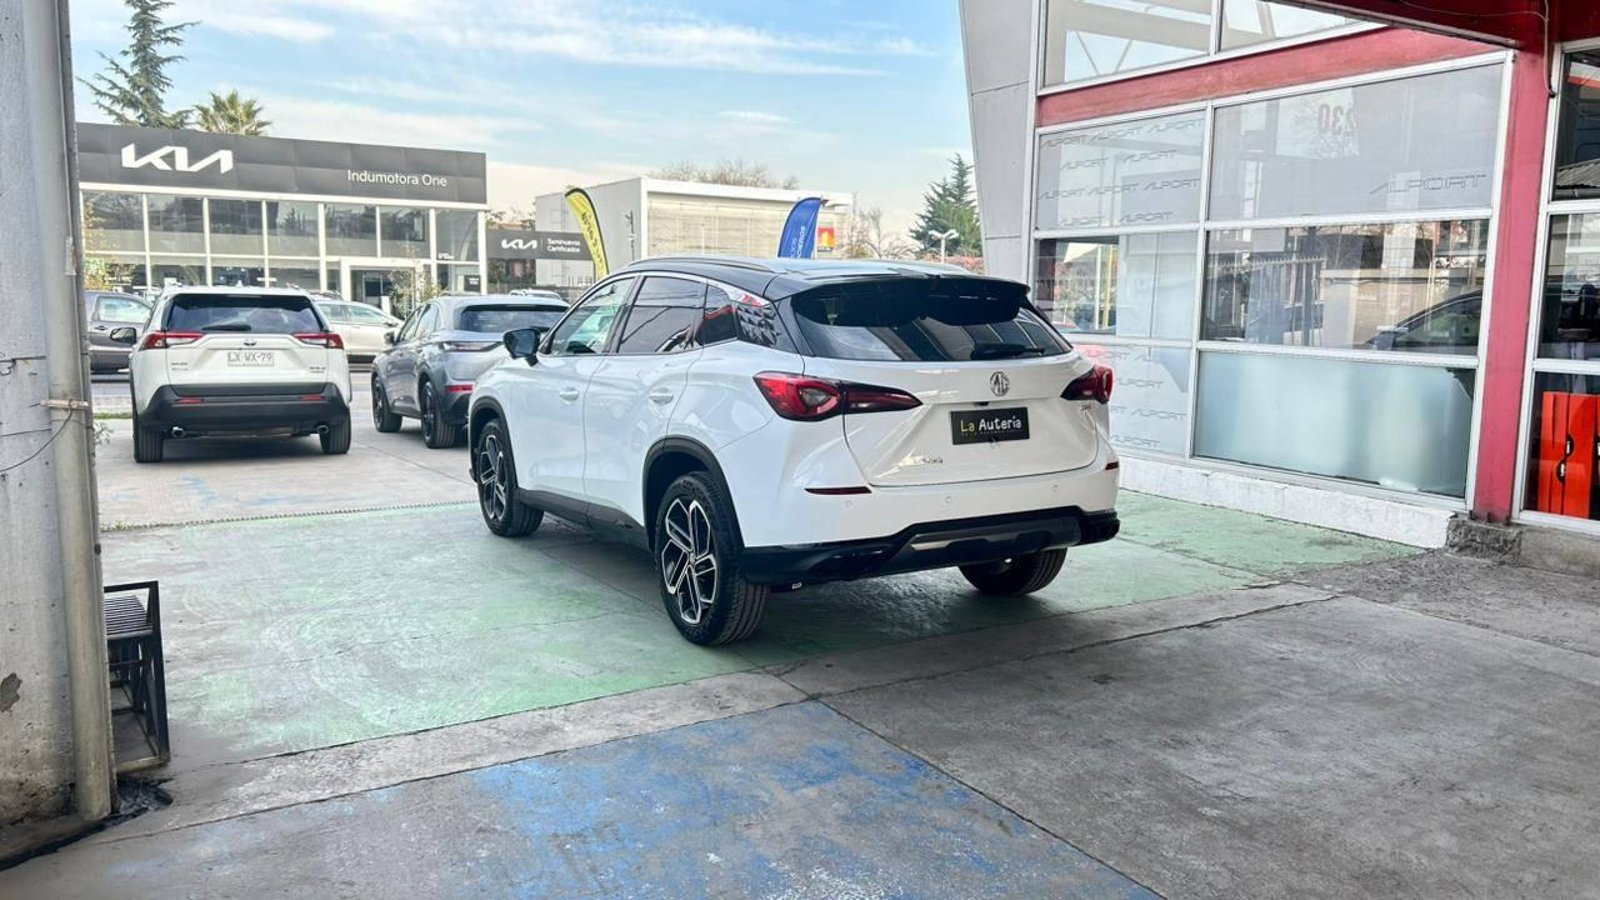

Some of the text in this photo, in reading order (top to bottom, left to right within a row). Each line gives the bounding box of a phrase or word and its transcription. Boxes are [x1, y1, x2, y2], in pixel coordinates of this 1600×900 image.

[121, 143, 234, 174] KIA
[347, 169, 448, 187] Indumotora One
[501, 238, 538, 250] KIA
[960, 418, 976, 432] La
